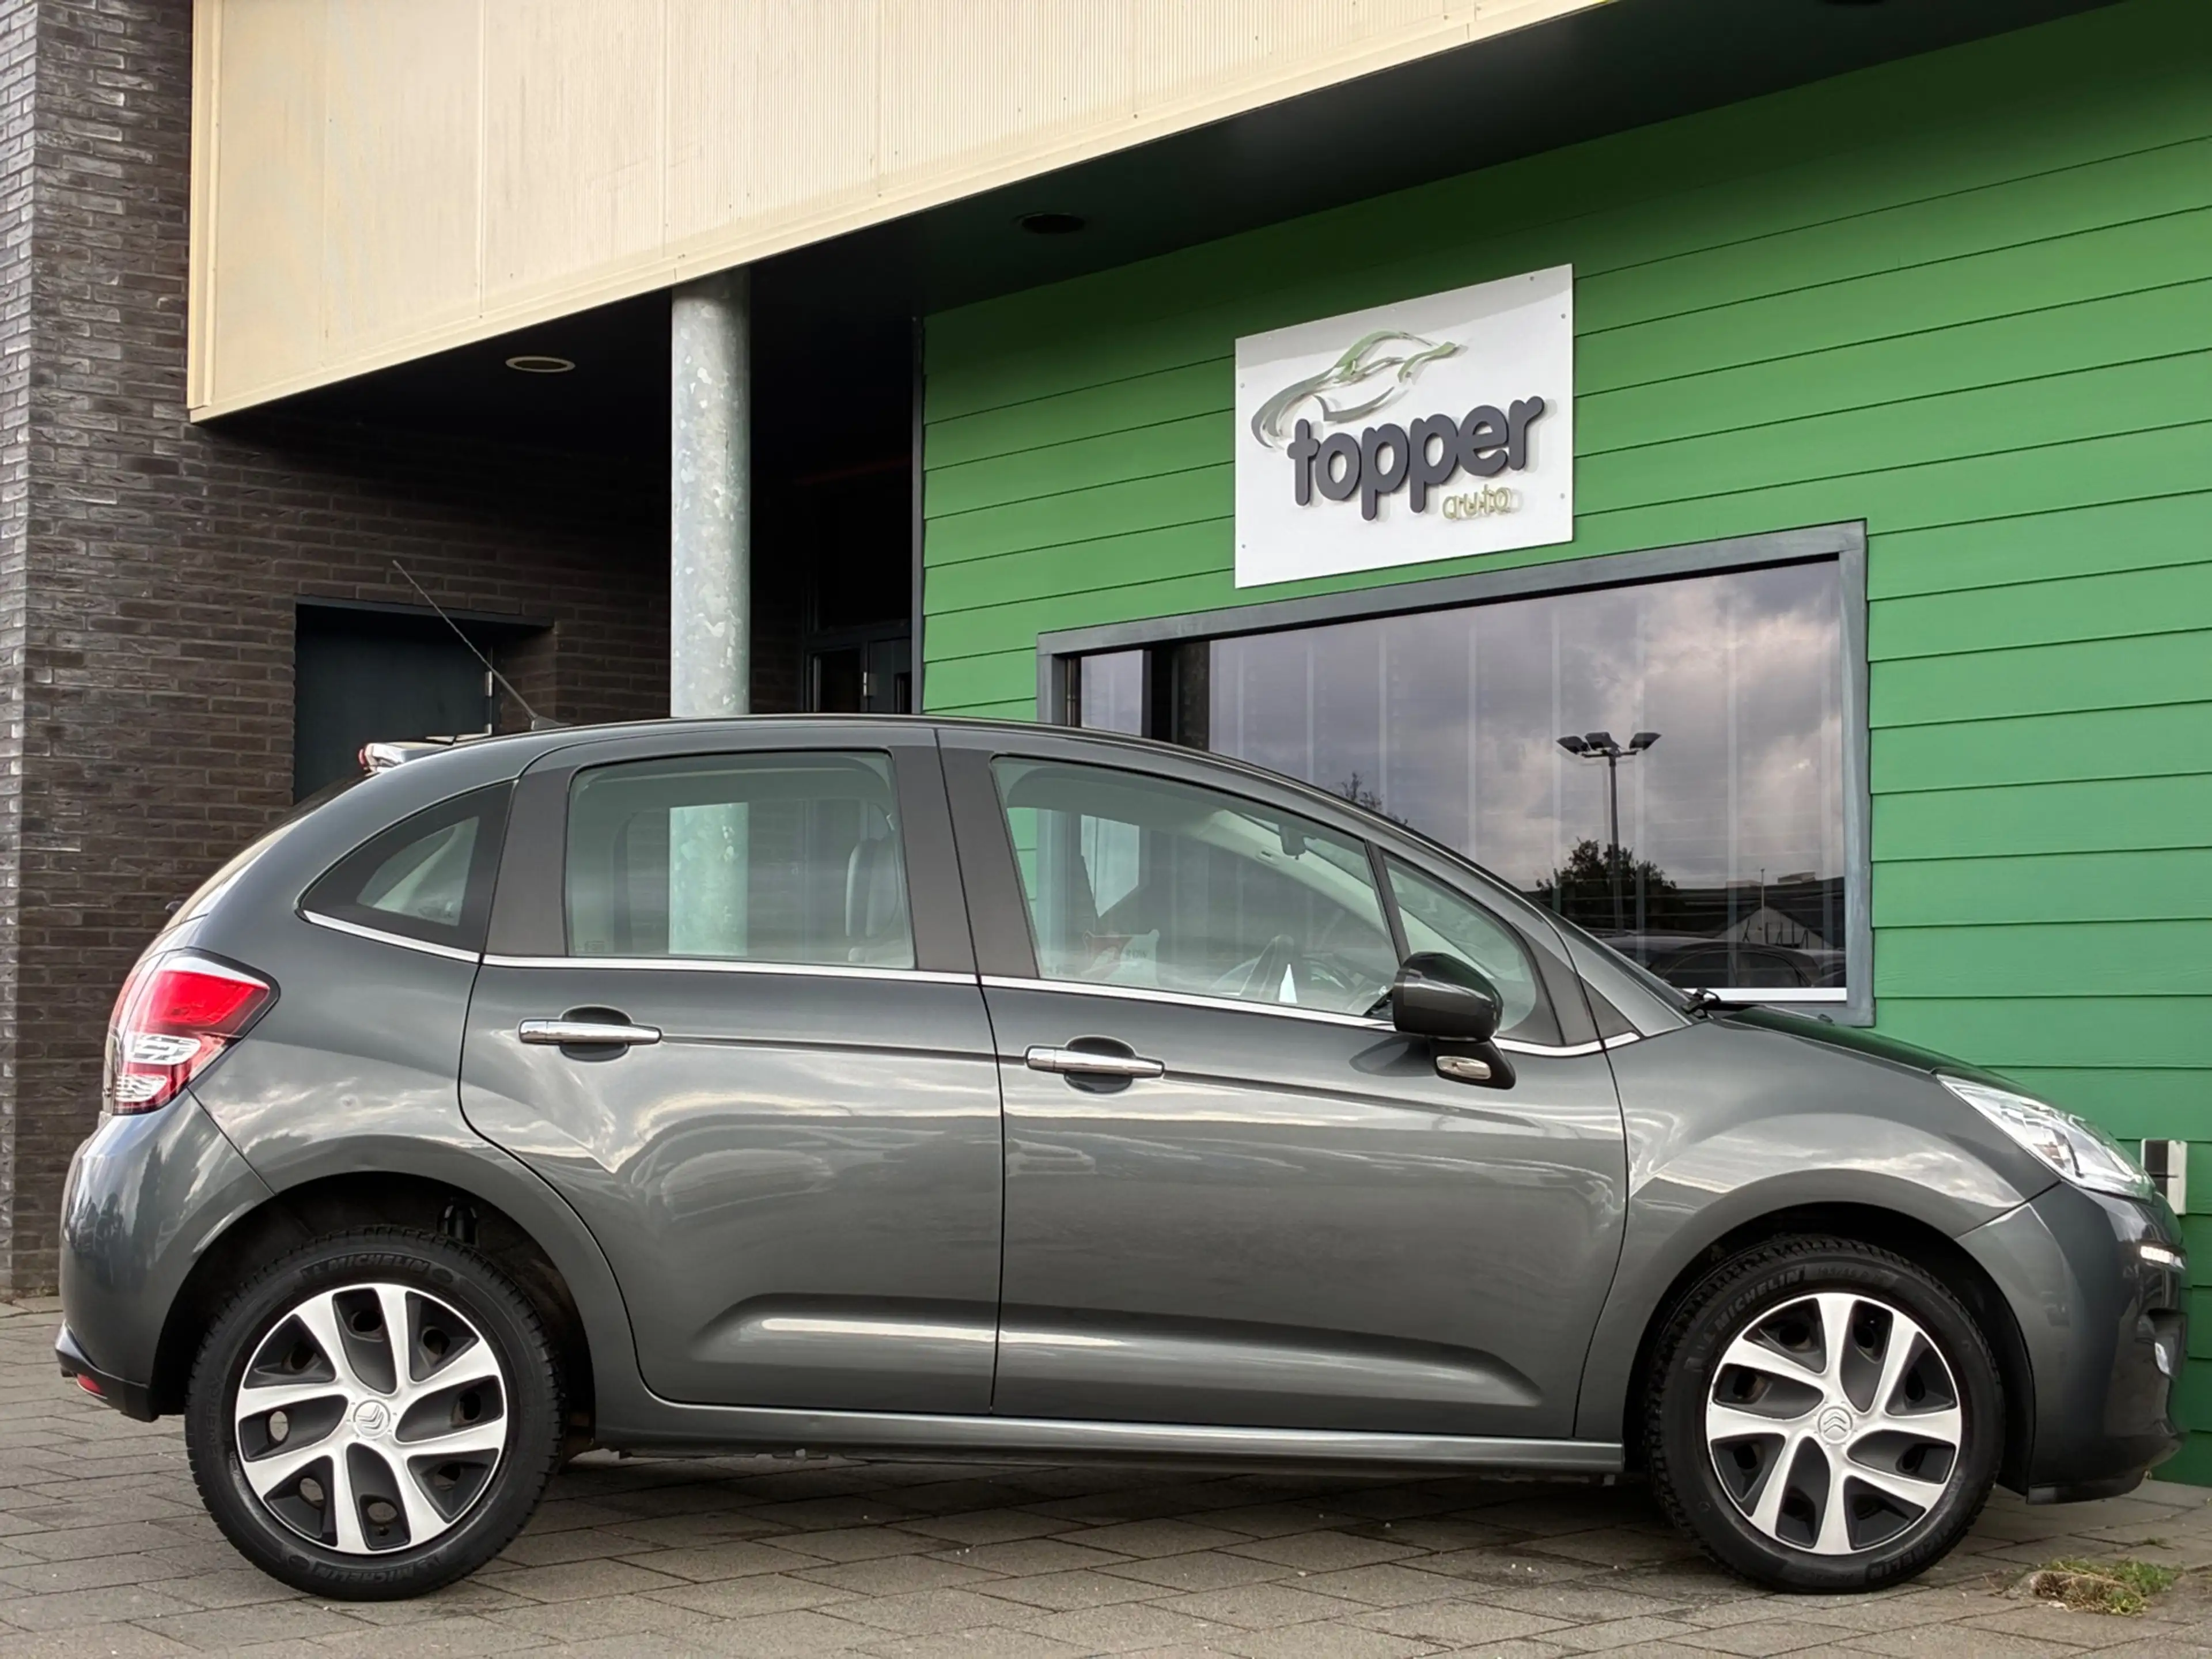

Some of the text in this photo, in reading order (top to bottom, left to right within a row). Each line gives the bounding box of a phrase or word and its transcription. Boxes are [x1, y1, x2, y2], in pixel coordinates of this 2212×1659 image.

[1286, 396, 1545, 521] topper
[1442, 484, 1512, 519] auto
[328, 1253, 431, 1272] MICHELIN
[1714, 1268, 1804, 1331] MICHELIN
[314, 1563, 415, 1584] MICHELIN
